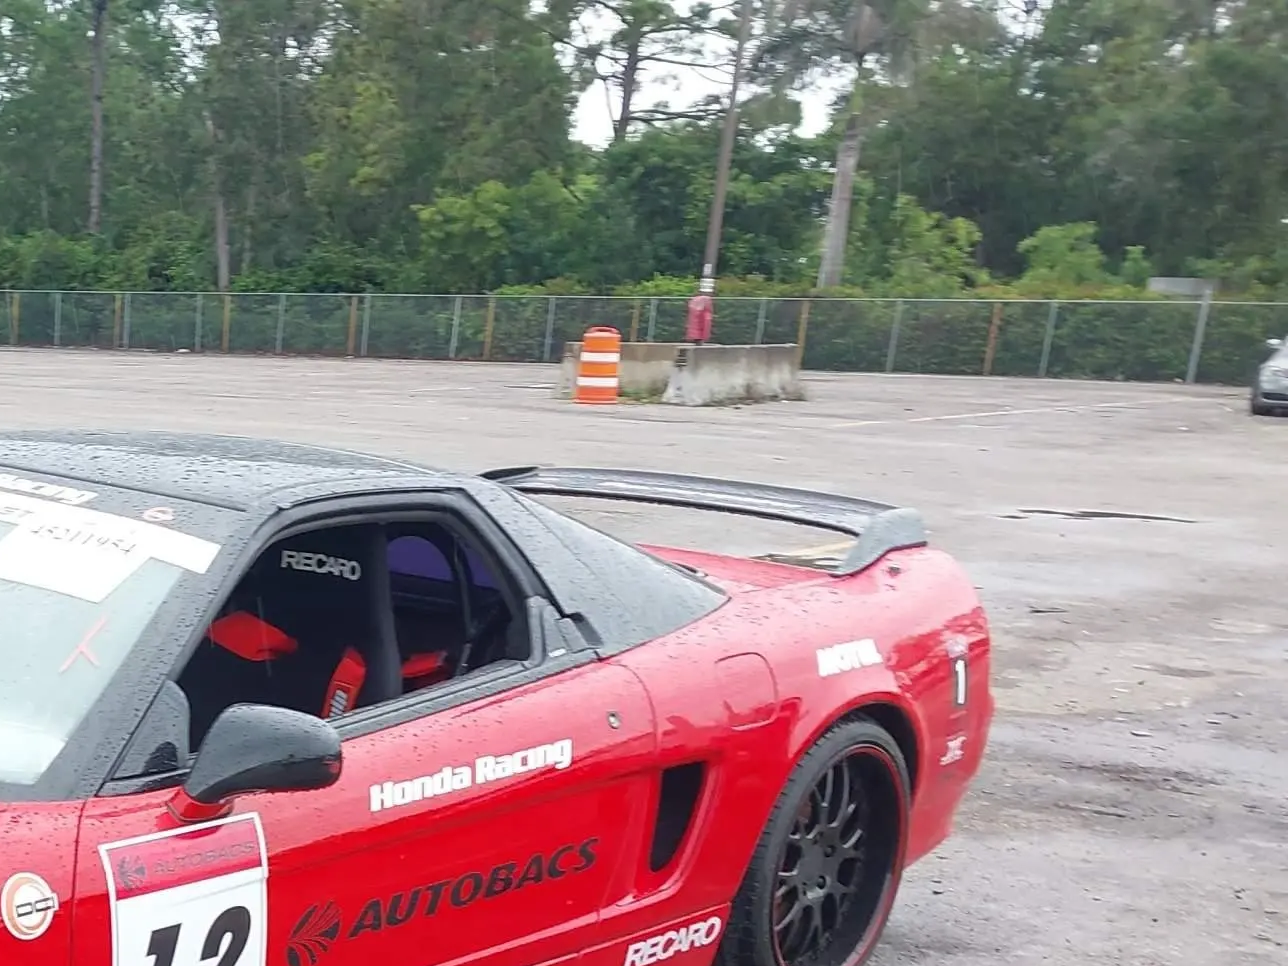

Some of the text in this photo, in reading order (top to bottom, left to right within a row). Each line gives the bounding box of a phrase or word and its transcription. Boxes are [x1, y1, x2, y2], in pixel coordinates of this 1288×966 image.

[280, 549, 362, 581] RECARO
[369, 738, 573, 813] Honda Racing
[347, 837, 600, 939] AUTOBACS
